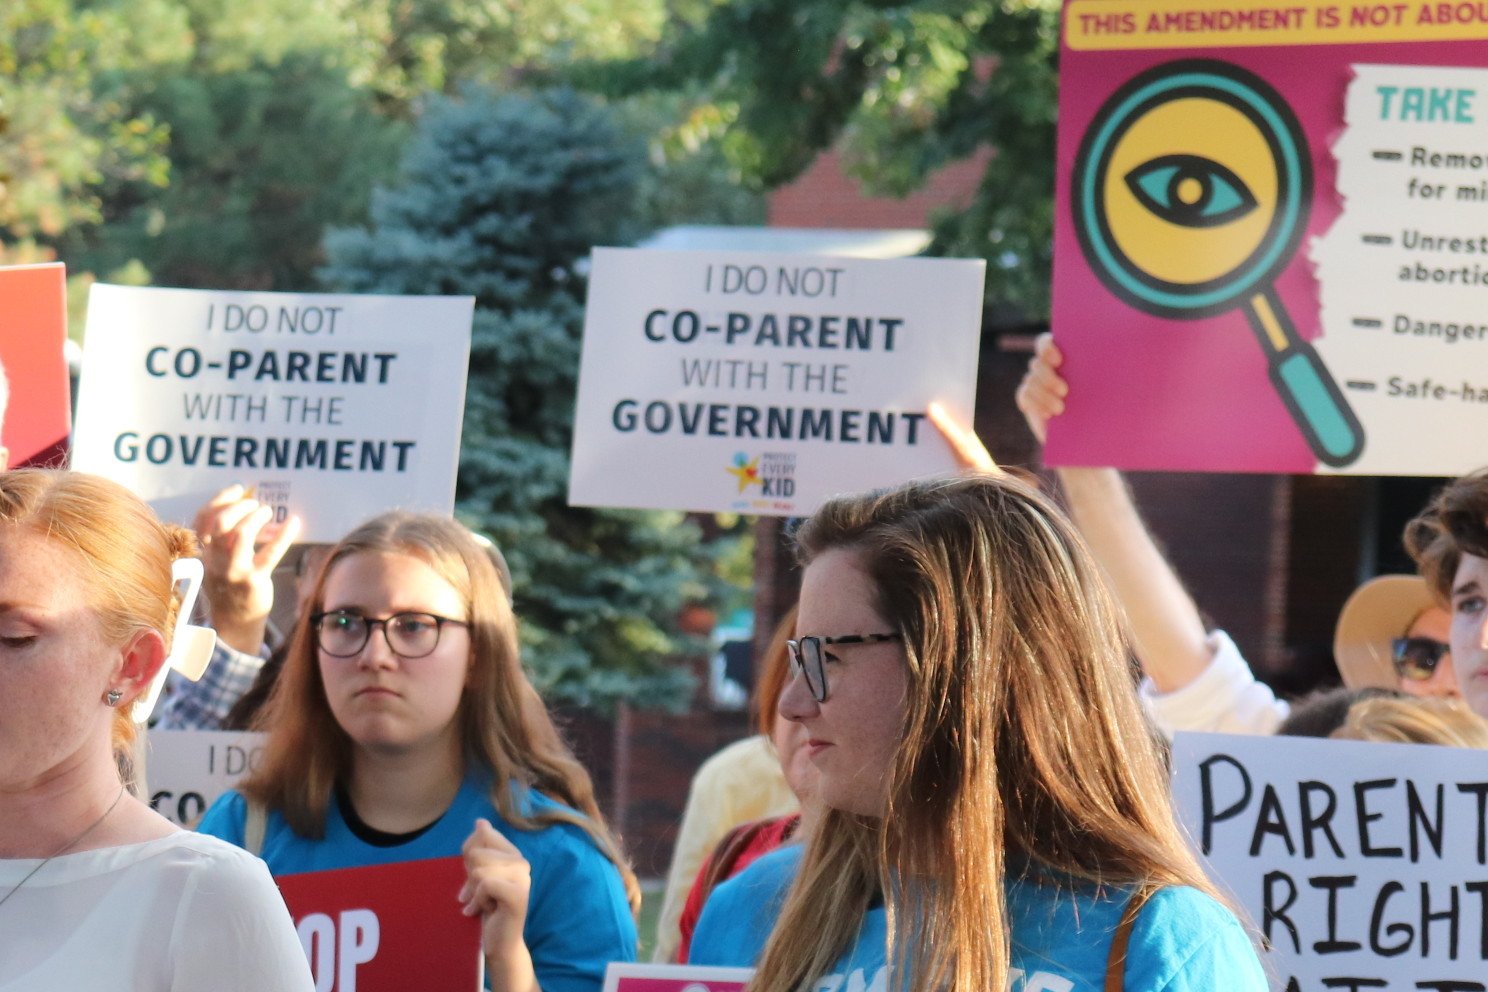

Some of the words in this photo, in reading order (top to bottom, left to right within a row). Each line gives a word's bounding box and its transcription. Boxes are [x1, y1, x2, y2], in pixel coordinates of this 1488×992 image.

[1078, 13, 1137, 36] THIS
[1145, 8, 1307, 34] AMENDMENT
[1315, 6, 1341, 28] IS
[1350, 4, 1407, 28] NOT
[1376, 86, 1476, 124] TAKE
[1406, 177, 1446, 200] for
[705, 264, 713, 293] I
[721, 264, 768, 296] DO
[777, 267, 846, 298] NOT
[206, 303, 215, 332] I
[223, 304, 269, 333] DO
[277, 306, 343, 335] NOT
[643, 308, 904, 351] CO-PARENT
[144, 344, 398, 384] CO-PARENT
[680, 358, 768, 390] WITH
[782, 362, 850, 394] THE
[183, 392, 267, 423] WITH
[281, 395, 345, 426] THE
[611, 399, 927, 446] GOVERNMENT
[113, 431, 417, 473] GOVERNMENT
[761, 477, 796, 498] KID
[1198, 752, 1488, 866] PARENT
